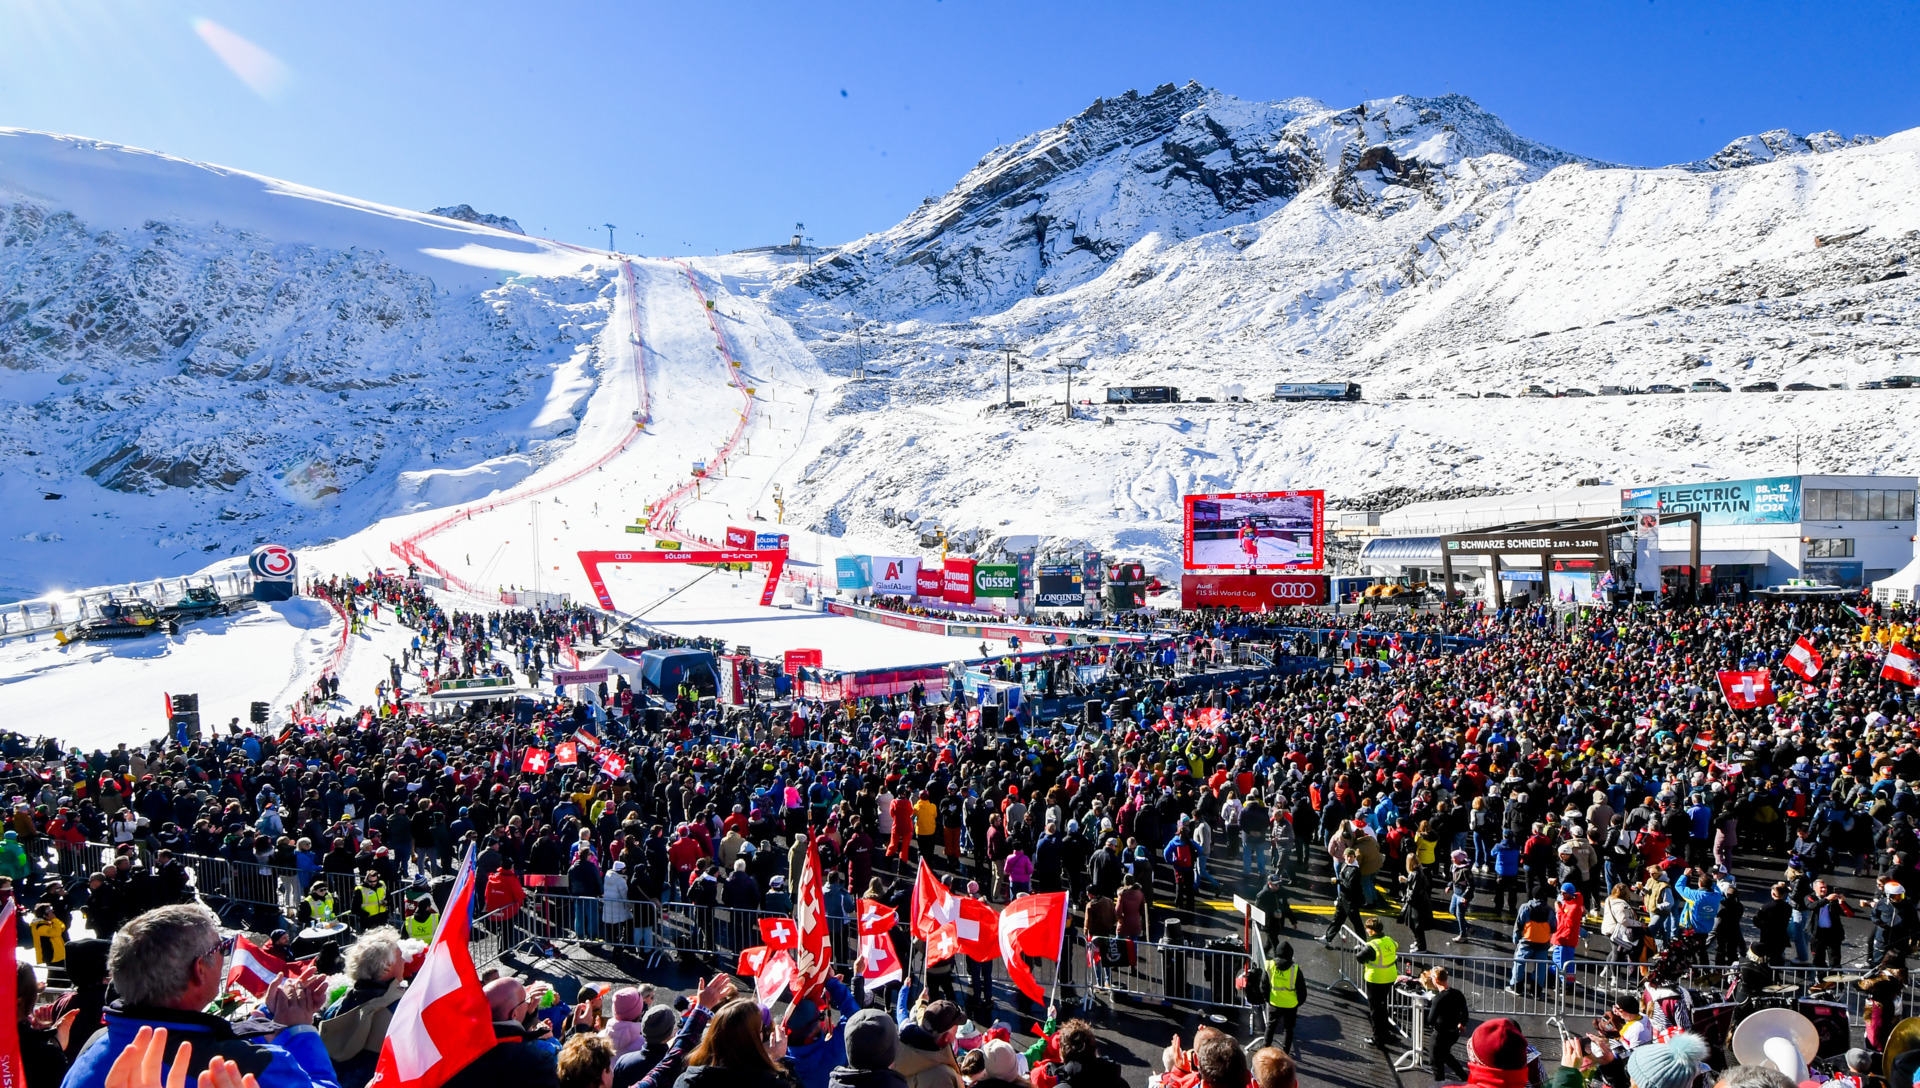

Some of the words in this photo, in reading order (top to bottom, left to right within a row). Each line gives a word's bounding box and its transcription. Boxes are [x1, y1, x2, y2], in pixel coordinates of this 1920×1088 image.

[1659, 486, 1741, 503] ELECTRIC
[1756, 484, 1770, 494] 08.
[1779, 484, 1792, 492] 12.
[1755, 494, 1788, 503] APRIL
[1659, 500, 1750, 513] MOUNTAIN
[1755, 504, 1784, 512] 2024
[1461, 540, 1505, 549] SCHWARZE
[1507, 539, 1551, 548] SCHNEIDE
[885, 560, 903, 580] A1
[945, 570, 969, 581] Kronen
[976, 570, 1016, 590] Gösser
[944, 581, 969, 593] Zeitung
